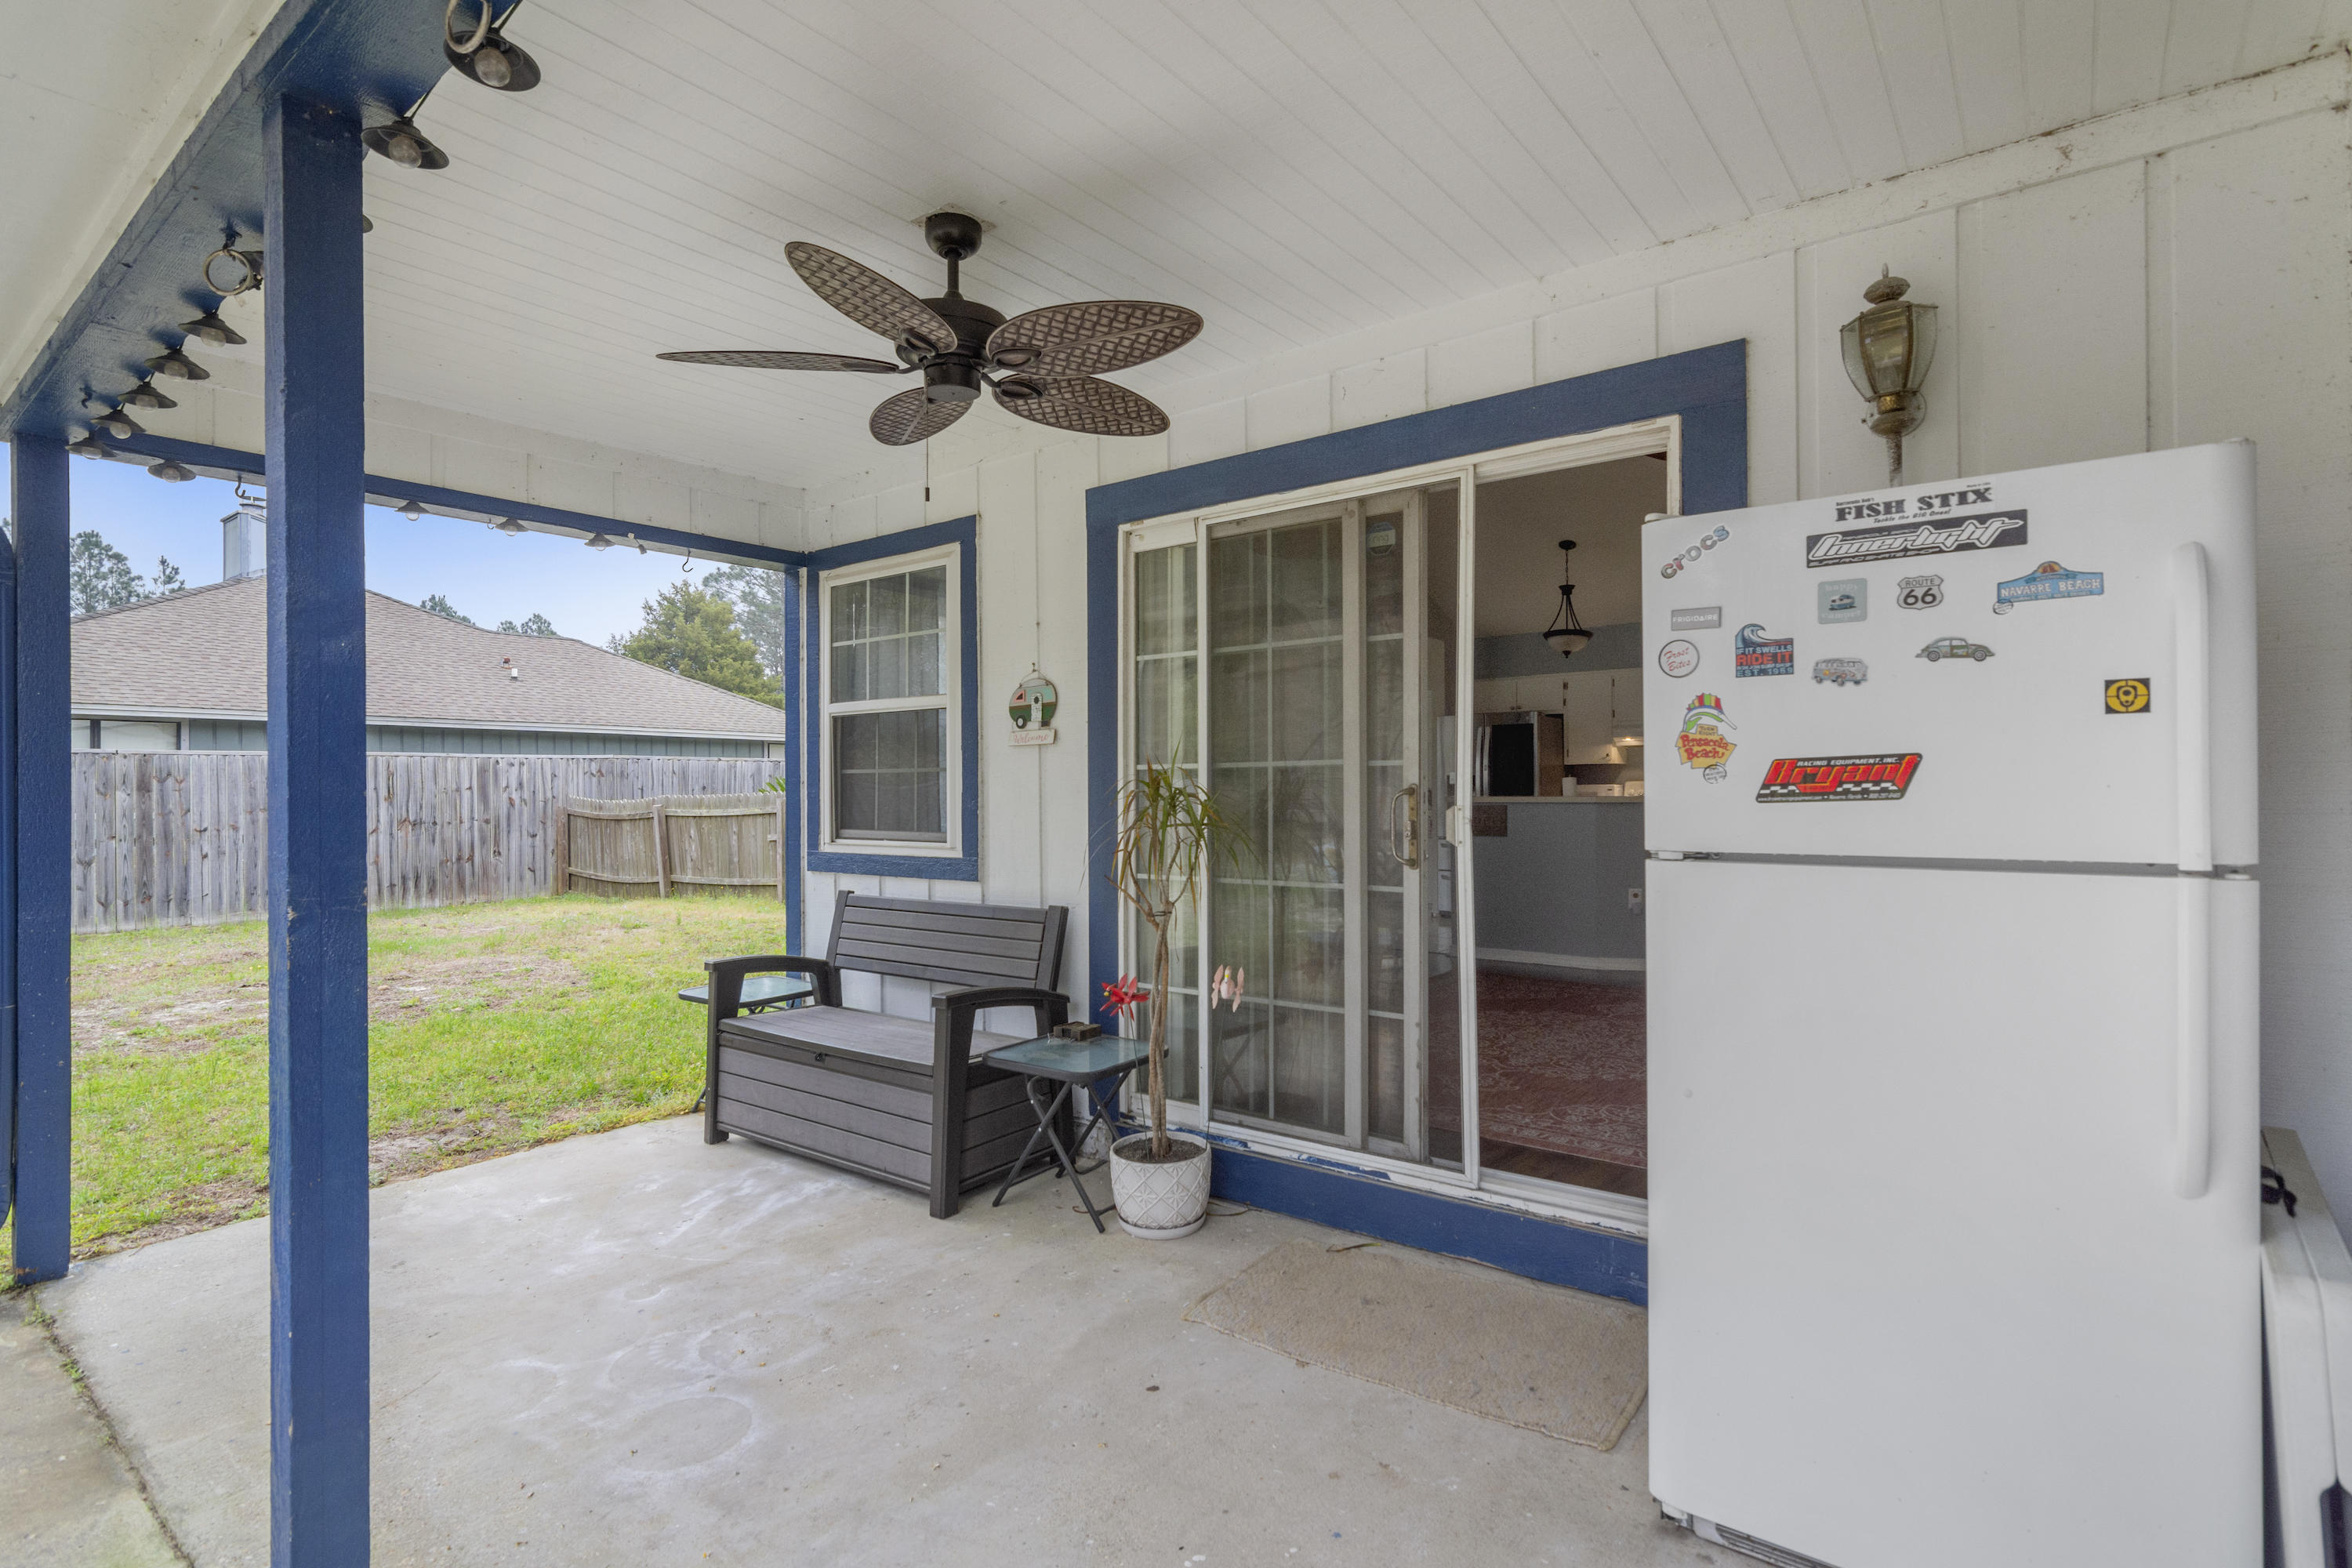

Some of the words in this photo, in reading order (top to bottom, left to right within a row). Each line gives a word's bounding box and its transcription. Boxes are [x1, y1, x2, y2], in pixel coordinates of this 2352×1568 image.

[1835, 499, 1906, 521] FISH
[1918, 487, 1992, 510] STIX
[1661, 525, 1730, 579] crocs
[1905, 578, 1935, 587] ROUTE
[2000, 583, 2052, 597] NAVARRE
[2058, 579, 2100, 591] BEACH
[1904, 588, 1937, 605] 66
[1756, 644, 1792, 653] SWELLS
[1737, 653, 1773, 666] RIDE
[1777, 652, 1792, 663] IT
[1680, 734, 1730, 750] Pensacola
[1684, 747, 1725, 760] Beach
[1764, 755, 1919, 793] Bryant
